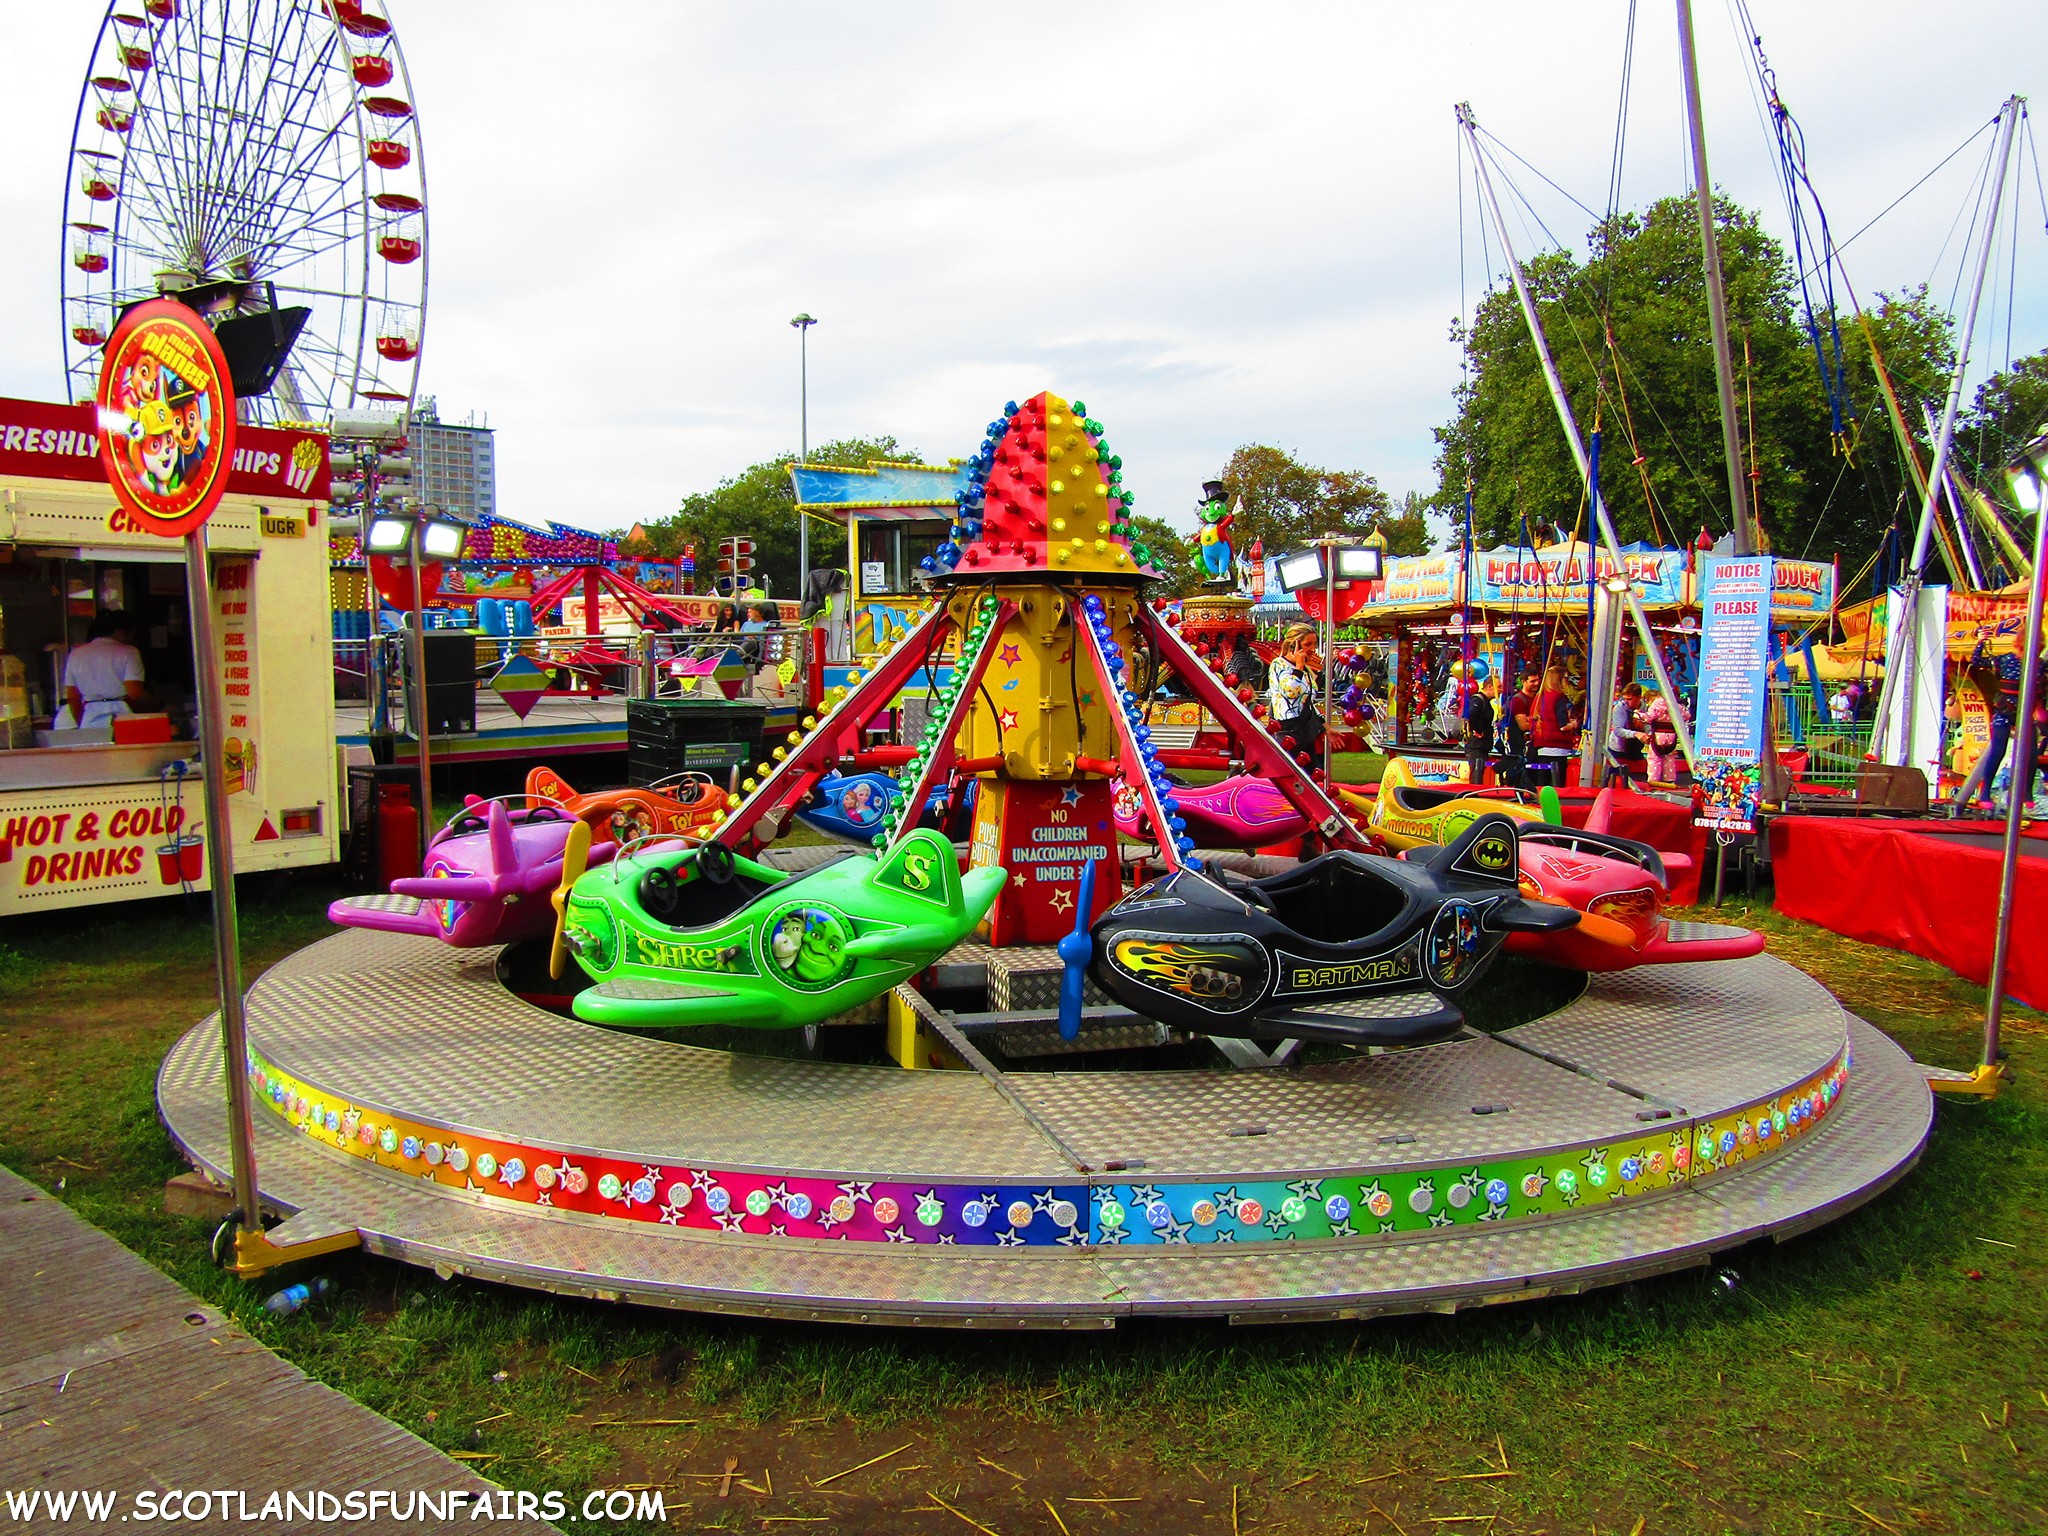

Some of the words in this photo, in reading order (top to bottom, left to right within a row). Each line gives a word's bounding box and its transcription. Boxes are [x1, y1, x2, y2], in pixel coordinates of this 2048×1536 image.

[167, 333, 196, 357] mini
[141, 332, 211, 390] planes
[231, 448, 281, 475] HIPS
[266, 520, 296, 535] UGR
[218, 564, 248, 591] MENU
[1487, 559, 1560, 585] HOOK
[1562, 557, 1581, 584] A
[1715, 563, 1761, 579] NOTICE
[1776, 562, 1823, 593] DUCK
[570, 601, 623, 618] CPS
[1713, 601, 1758, 615] PLEASE
[544, 627, 571, 636] PANINIS
[1963, 703, 1984, 712] WIN
[1701, 747, 1712, 756] DO
[1713, 748, 1734, 757] HAVE
[1735, 749, 1754, 758] FUN!
[1431, 761, 1460, 777] DUCK
[668, 811, 693, 831] TOY
[1051, 809, 1068, 823] NO
[1694, 818, 1719, 828] 07816
[1720, 820, 1752, 831] 642876
[6, 813, 71, 847] HOT
[75, 812, 100, 842] &
[109, 805, 185, 839] COLD
[979, 821, 999, 847] PUSH
[1032, 826, 1088, 842] CHILDREN
[972, 840, 1000, 867] BUTTON
[1012, 846, 1108, 862] UNACCOMPANIED
[25, 845, 144, 886] DRINKS
[1036, 866, 1075, 882] UNDER
[1293, 960, 1410, 988] BATMAN
